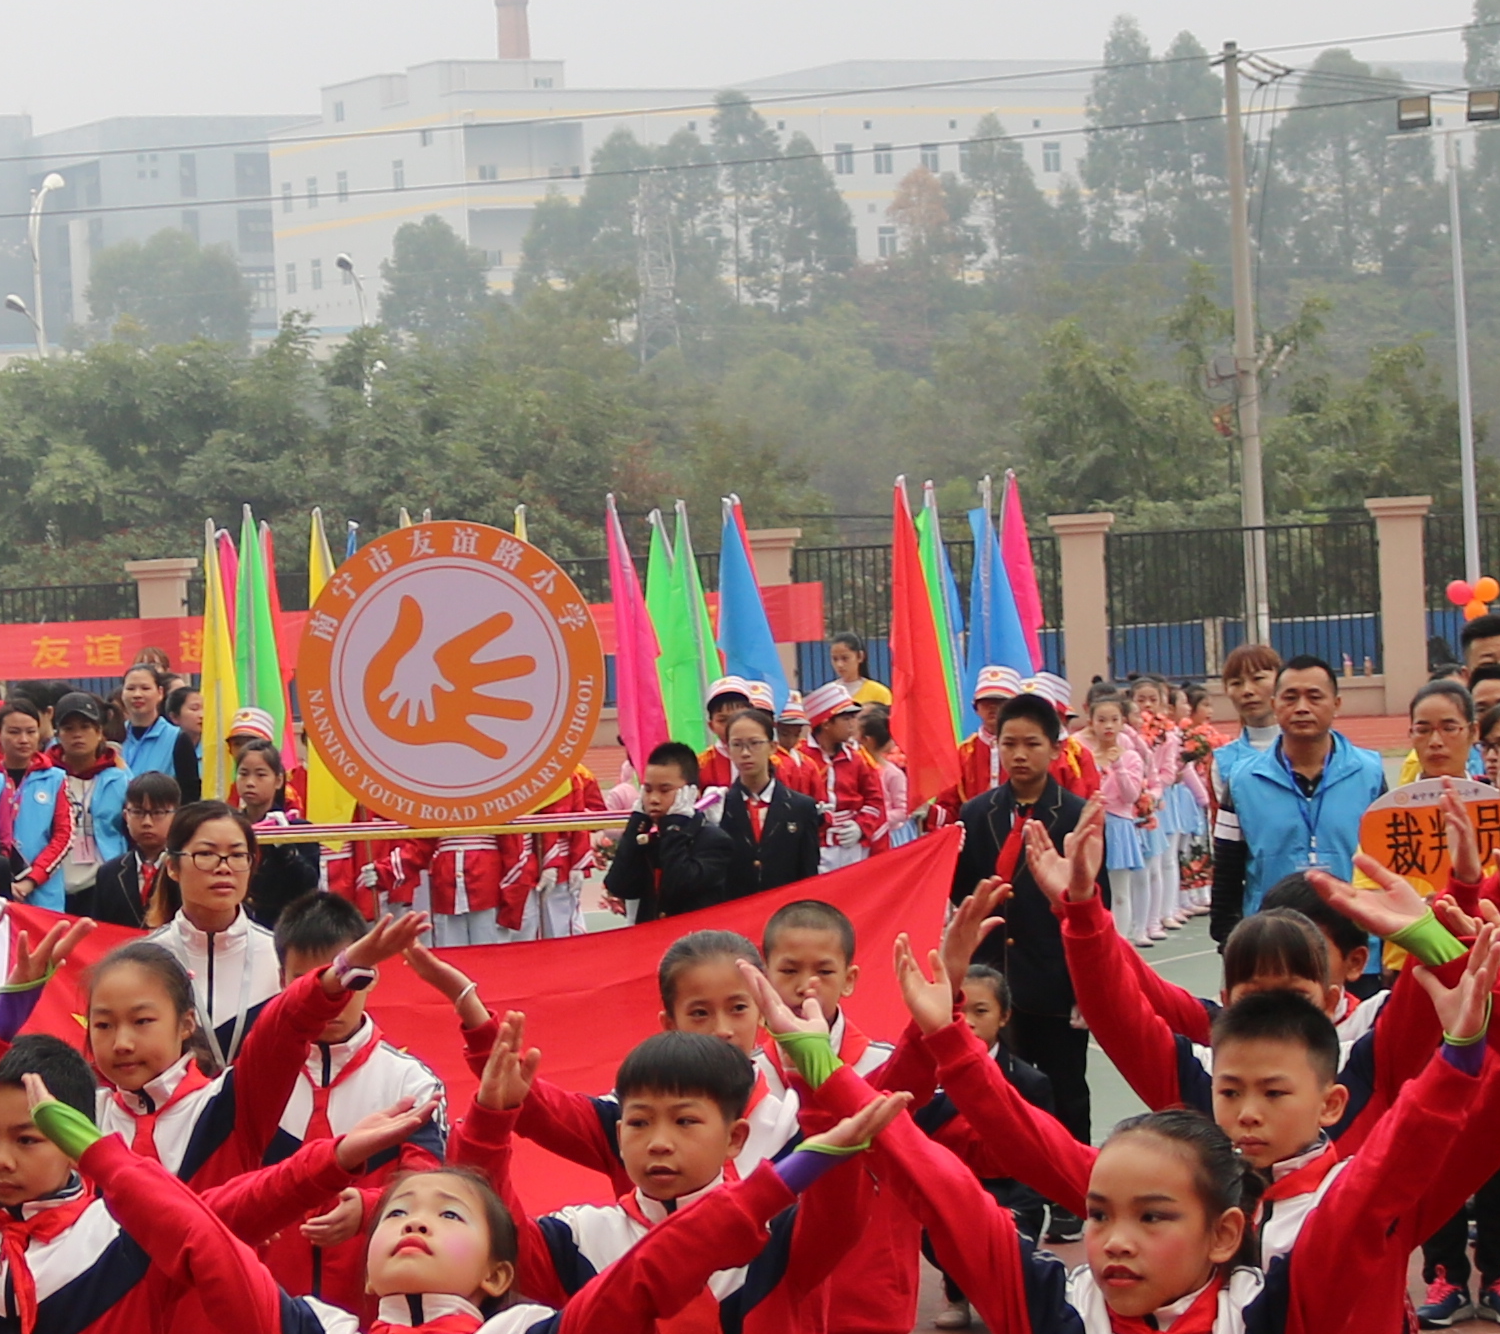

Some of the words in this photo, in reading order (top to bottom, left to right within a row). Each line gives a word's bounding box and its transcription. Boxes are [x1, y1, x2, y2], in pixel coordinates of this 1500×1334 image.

[309, 527, 588, 643] 南宁市友谊路小学
[308, 688, 359, 778] NANNING
[358, 777, 414, 816] YOUYI
[419, 803, 477, 822] ROAD
[483, 762, 563, 818] PRIMARY
[559, 673, 594, 758] SCHOOL
